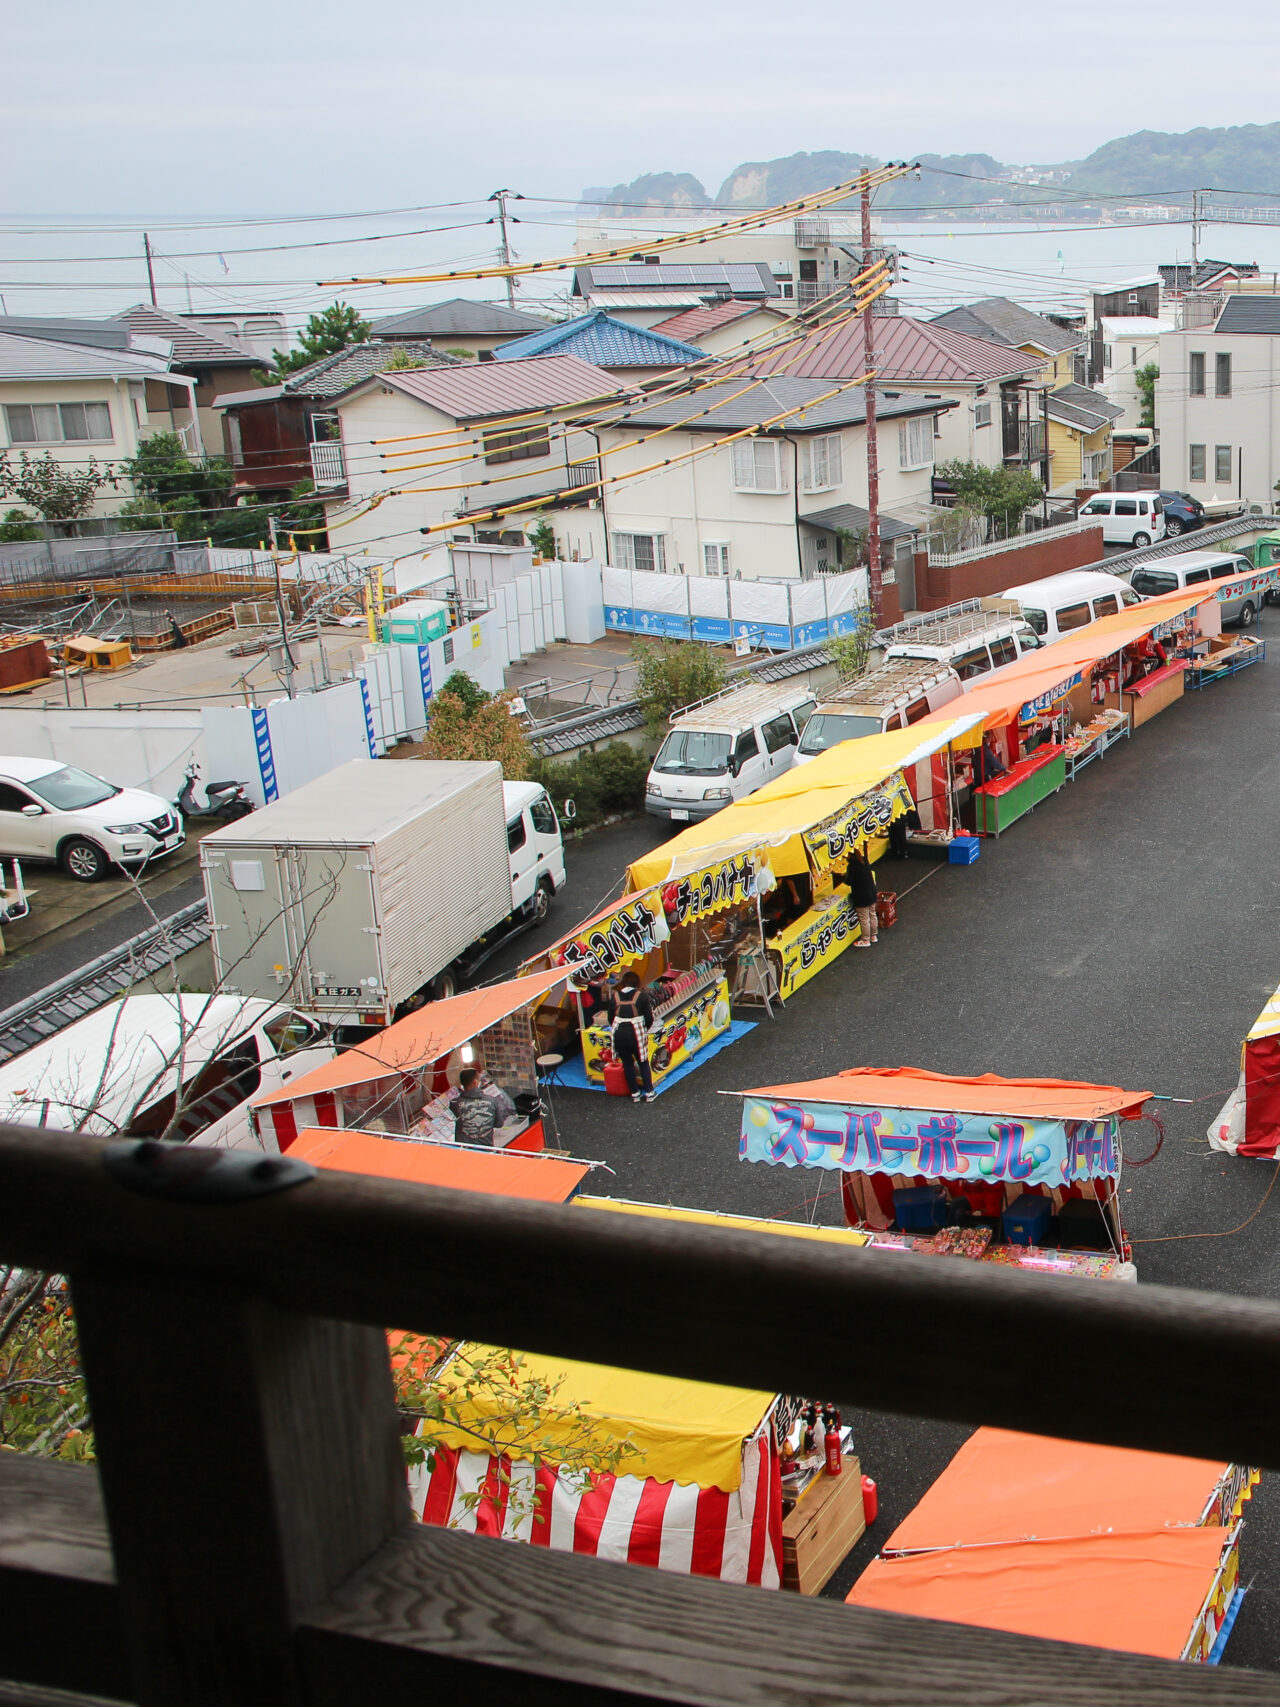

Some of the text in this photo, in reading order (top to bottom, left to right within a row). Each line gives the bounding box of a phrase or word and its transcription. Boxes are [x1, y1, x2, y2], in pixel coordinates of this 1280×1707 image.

[676, 855, 755, 922] チョコバナナ
[317, 987, 360, 996] 高圧ガス
[770, 1105, 1034, 1180] スーパーボール
